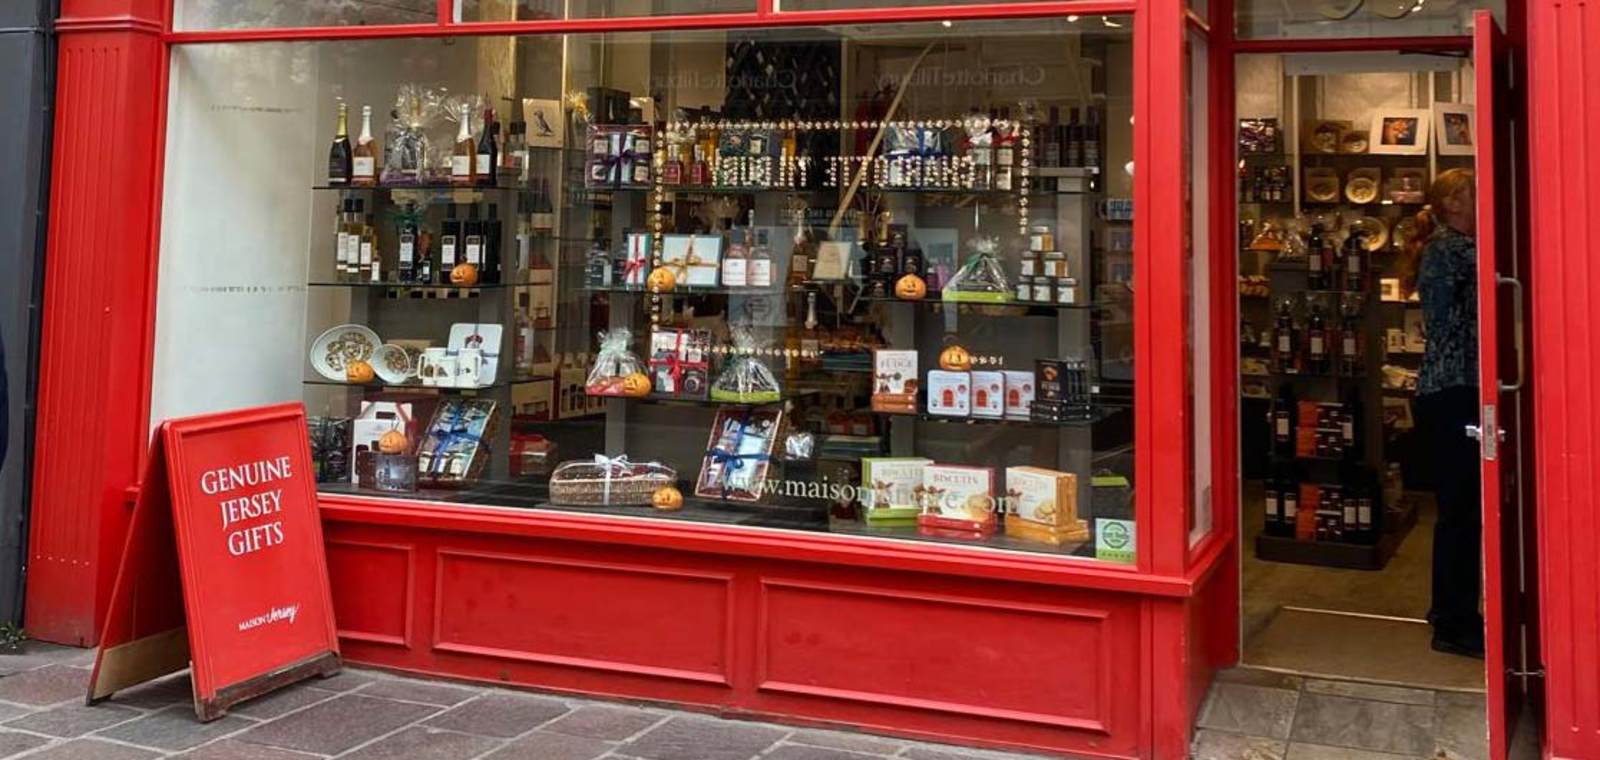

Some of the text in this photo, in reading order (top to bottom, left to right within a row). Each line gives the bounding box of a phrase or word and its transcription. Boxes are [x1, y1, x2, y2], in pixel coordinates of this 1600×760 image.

[201, 456, 292, 495] GENUINE
[933, 472, 979, 484] BISCUITS
[221, 489, 281, 531] JERSEY
[228, 521, 284, 556] GIFTS
[239, 603, 300, 631] MAISON Jersey
